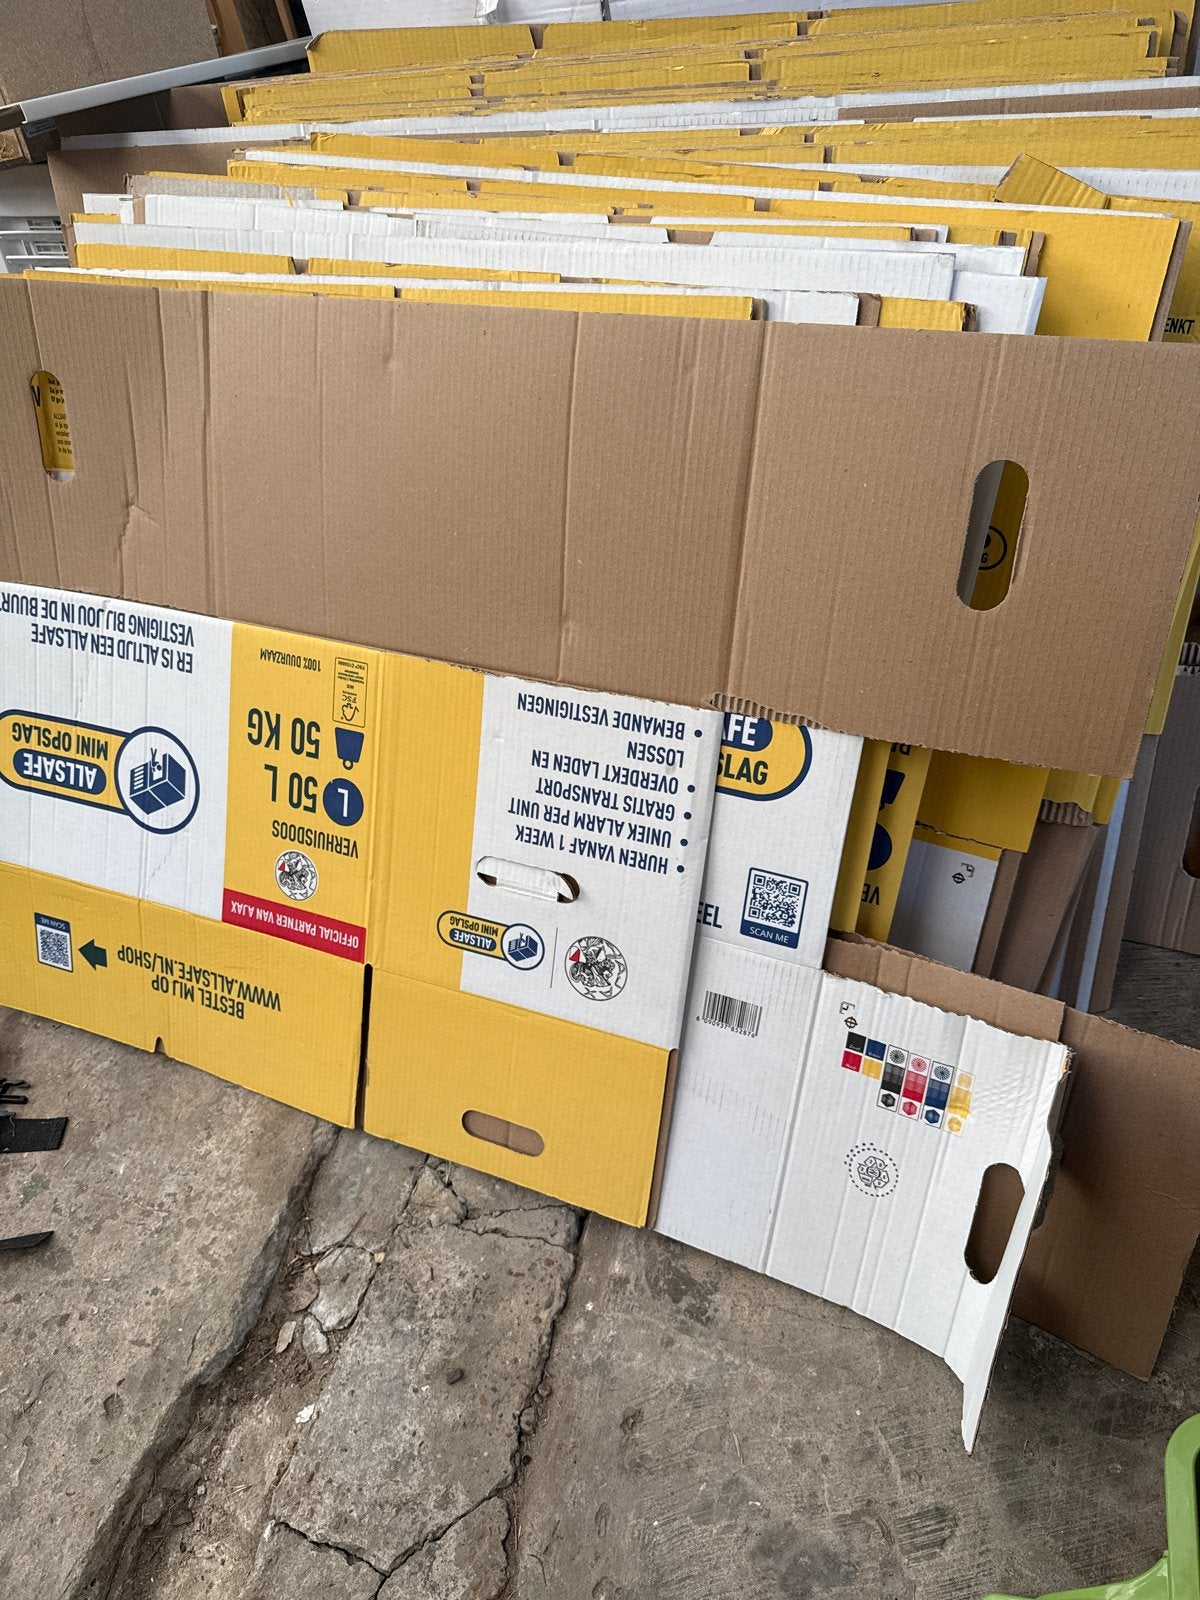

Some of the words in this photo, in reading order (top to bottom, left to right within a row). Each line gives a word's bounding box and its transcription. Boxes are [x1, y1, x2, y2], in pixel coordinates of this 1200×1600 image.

[0, 592, 38, 616] BUUR
[41, 599, 57, 620] DE
[61, 602, 74, 623] IN
[78, 605, 105, 627] JOU
[106, 610, 125, 632] BIJ
[128, 615, 194, 647] VESTIGING
[31, 623, 88, 651] ALLSAFE
[91, 634, 114, 657] EEN
[117, 639, 159, 666] ALTIJD
[161, 648, 173, 670] IS
[177, 651, 193, 674] ER
[260, 648, 301, 668] DUURZAAM
[303, 657, 321, 672] 100%
[517, 693, 608, 727] VESTIGINGEN
[12, 722, 72, 752] OPSLAG
[247, 708, 281, 751] KG
[612, 710, 686, 740] BEMANDE
[76, 735, 108, 761] MINI
[291, 718, 320, 760] 50
[531, 749, 549, 769] EN
[553, 754, 600, 779] LADEN
[626, 741, 685, 768] LOSSEN
[23, 752, 97, 790] ALLSAFE
[264, 764, 278, 802] L
[602, 764, 679, 795] OVERDEKT
[288, 772, 318, 814] 50
[338, 788, 348, 818] L
[535, 777, 619, 810] TRANSPORT
[507, 797, 540, 819] UNIT
[543, 804, 570, 826] PER
[623, 795, 675, 822] GRATIS
[514, 824, 554, 849] WEEK
[573, 811, 625, 838] ALARM
[627, 823, 672, 848] UNIEK
[272, 820, 359, 859] VERHUISDOOS
[559, 834, 565, 850] 1
[568, 837, 614, 863] VANAF
[619, 848, 668, 875] HUREN
[231, 901, 254, 916] AJAX
[256, 908, 274, 924] VAN
[276, 914, 317, 936] PARTNER
[450, 916, 480, 931] OPSLAG
[481, 924, 499, 937] MINI
[749, 927, 773, 940] SCAN
[775, 933, 789, 944] ME
[318, 926, 359, 949] OFFICIAL
[453, 929, 493, 949] ALLSAFE
[117, 945, 282, 1012] WWW.ALLSAFE.NL/SHOP
[150, 974, 169, 993] OP
[172, 979, 195, 1003] MIJ
[197, 987, 245, 1020] BESTEL
